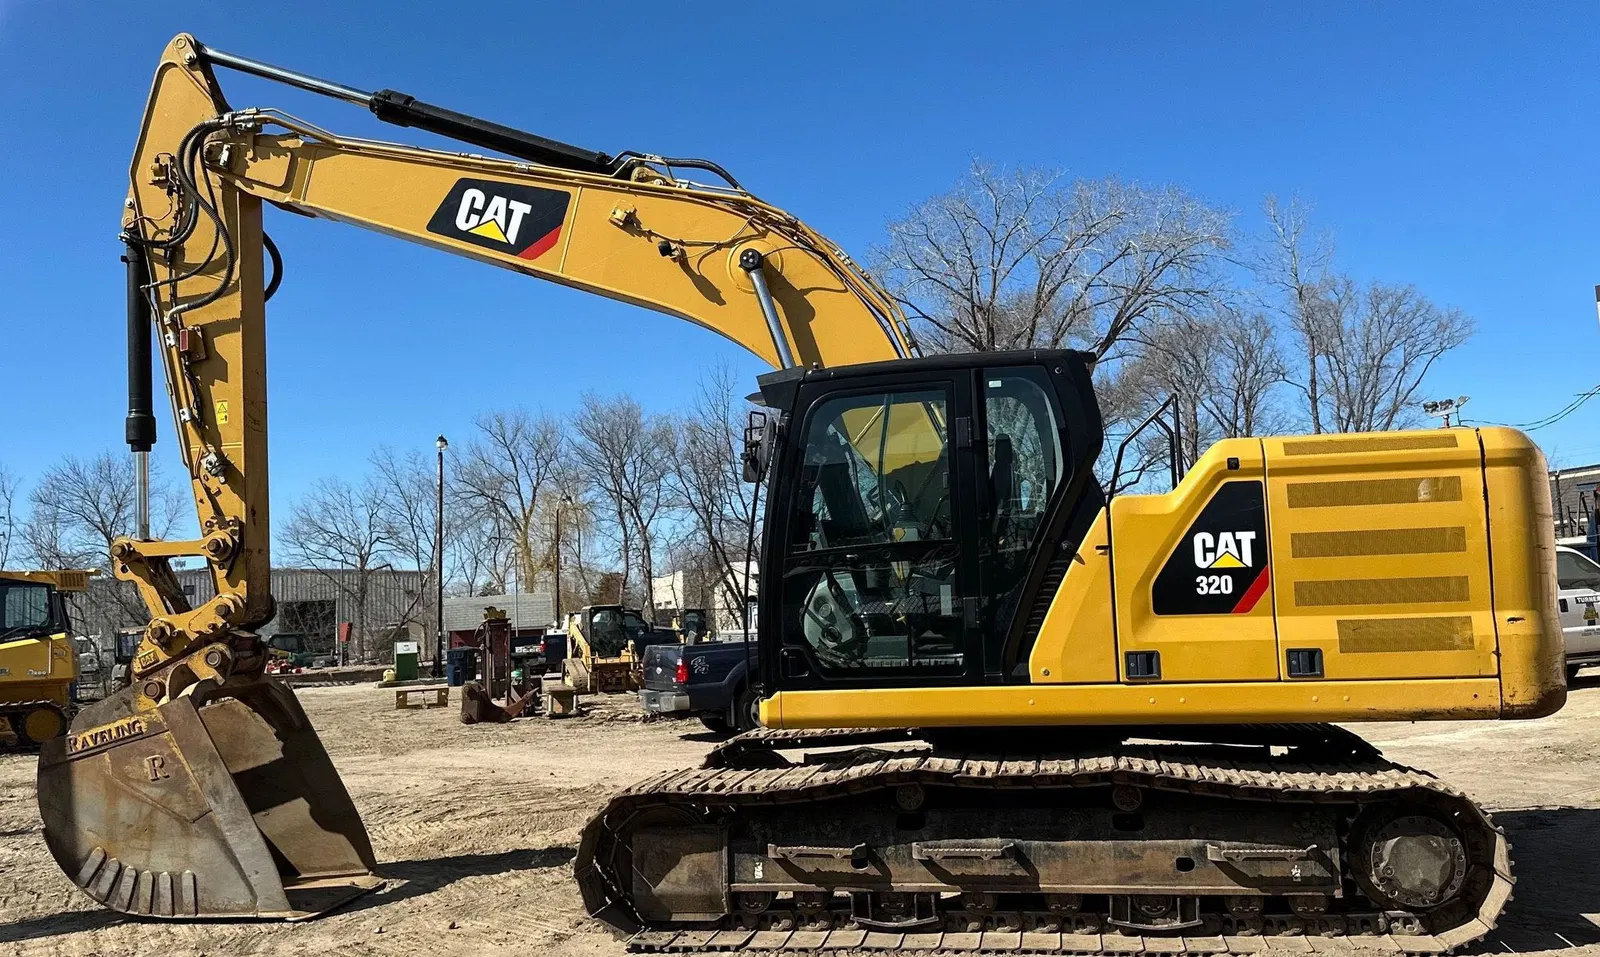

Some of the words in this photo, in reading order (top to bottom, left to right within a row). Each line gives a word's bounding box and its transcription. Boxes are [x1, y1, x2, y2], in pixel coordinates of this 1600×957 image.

[455, 188, 532, 245] CAT
[1193, 531, 1256, 569] CAT
[1196, 575, 1233, 595] 320
[140, 652, 155, 667] CAT
[67, 720, 144, 753] RAVELING
[145, 754, 170, 782] R
